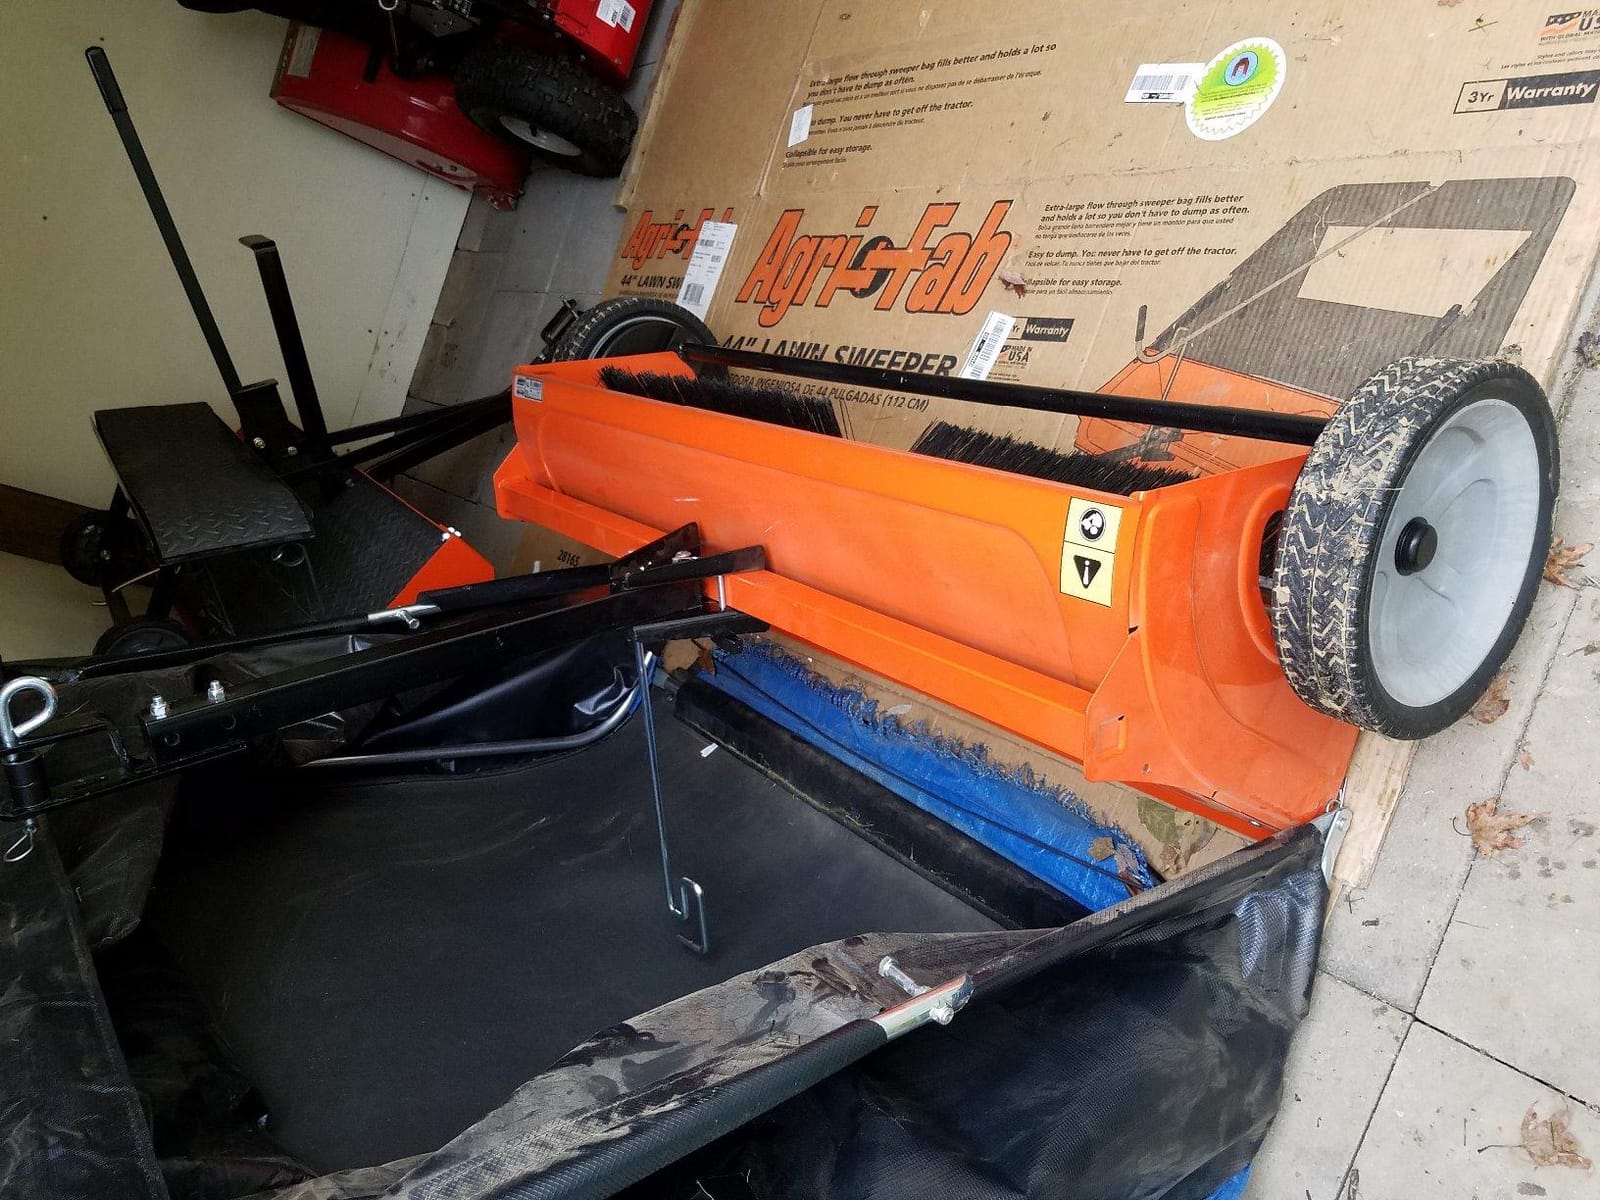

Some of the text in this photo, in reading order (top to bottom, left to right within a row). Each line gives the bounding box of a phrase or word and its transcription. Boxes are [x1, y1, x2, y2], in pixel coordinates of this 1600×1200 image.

[843, 73, 859, 82] flow
[860, 69, 888, 80] through
[889, 64, 920, 77] sweeper
[920, 61, 936, 71] bag
[936, 58, 952, 68] fills
[953, 54, 979, 65] better
[979, 51, 997, 62] and
[997, 47, 1021, 60] holds
[1030, 43, 1044, 54] lot
[1045, 43, 1057, 52] so
[807, 76, 915, 100] you don't have to dump as often.
[1507, 82, 1596, 101] Warranty
[817, 117, 837, 127] dump.
[839, 115, 852, 123] You
[852, 112, 873, 121] never
[873, 109, 891, 119] have
[892, 108, 900, 117] to
[901, 107, 915, 117] get
[915, 103, 929, 114] off
[929, 102, 942, 113] the
[944, 100, 974, 111] tractor.
[785, 144, 873, 159] Collapsible for easy storage.
[1045, 194, 1244, 212] Extra-large flow through sweeper bag fills better
[1040, 214, 1055, 222] and
[1056, 213, 1077, 221] holds
[1084, 212, 1097, 221] lot
[1108, 213, 1124, 221] you
[1124, 210, 1147, 219] don't
[1148, 209, 1169, 218] have
[1182, 207, 1208, 217] dump
[1222, 205, 1250, 215] often.
[621, 207, 734, 270] Agri-F
[1028, 246, 1237, 260] Easy to dump. You never have to get off the tractor.
[735, 199, 1014, 328] Agri-Fab
[620, 275, 637, 287] 44"
[637, 275, 666, 288] LAWN
[1058, 277, 1071, 286] for
[1071, 278, 1089, 288] easy
[1090, 278, 1123, 288] storage.
[1026, 324, 1069, 337] Warranty
[761, 338, 829, 361] LAWN
[834, 345, 958, 377] SWEEPER
[1008, 351, 1029, 363] USA
[755, 376, 802, 393] INGENIOSA
[802, 383, 817, 395] DE
[817, 385, 829, 397] 44
[828, 386, 882, 406] PULGADAS
[882, 393, 905, 409] (112
[906, 397, 930, 413] CM)
